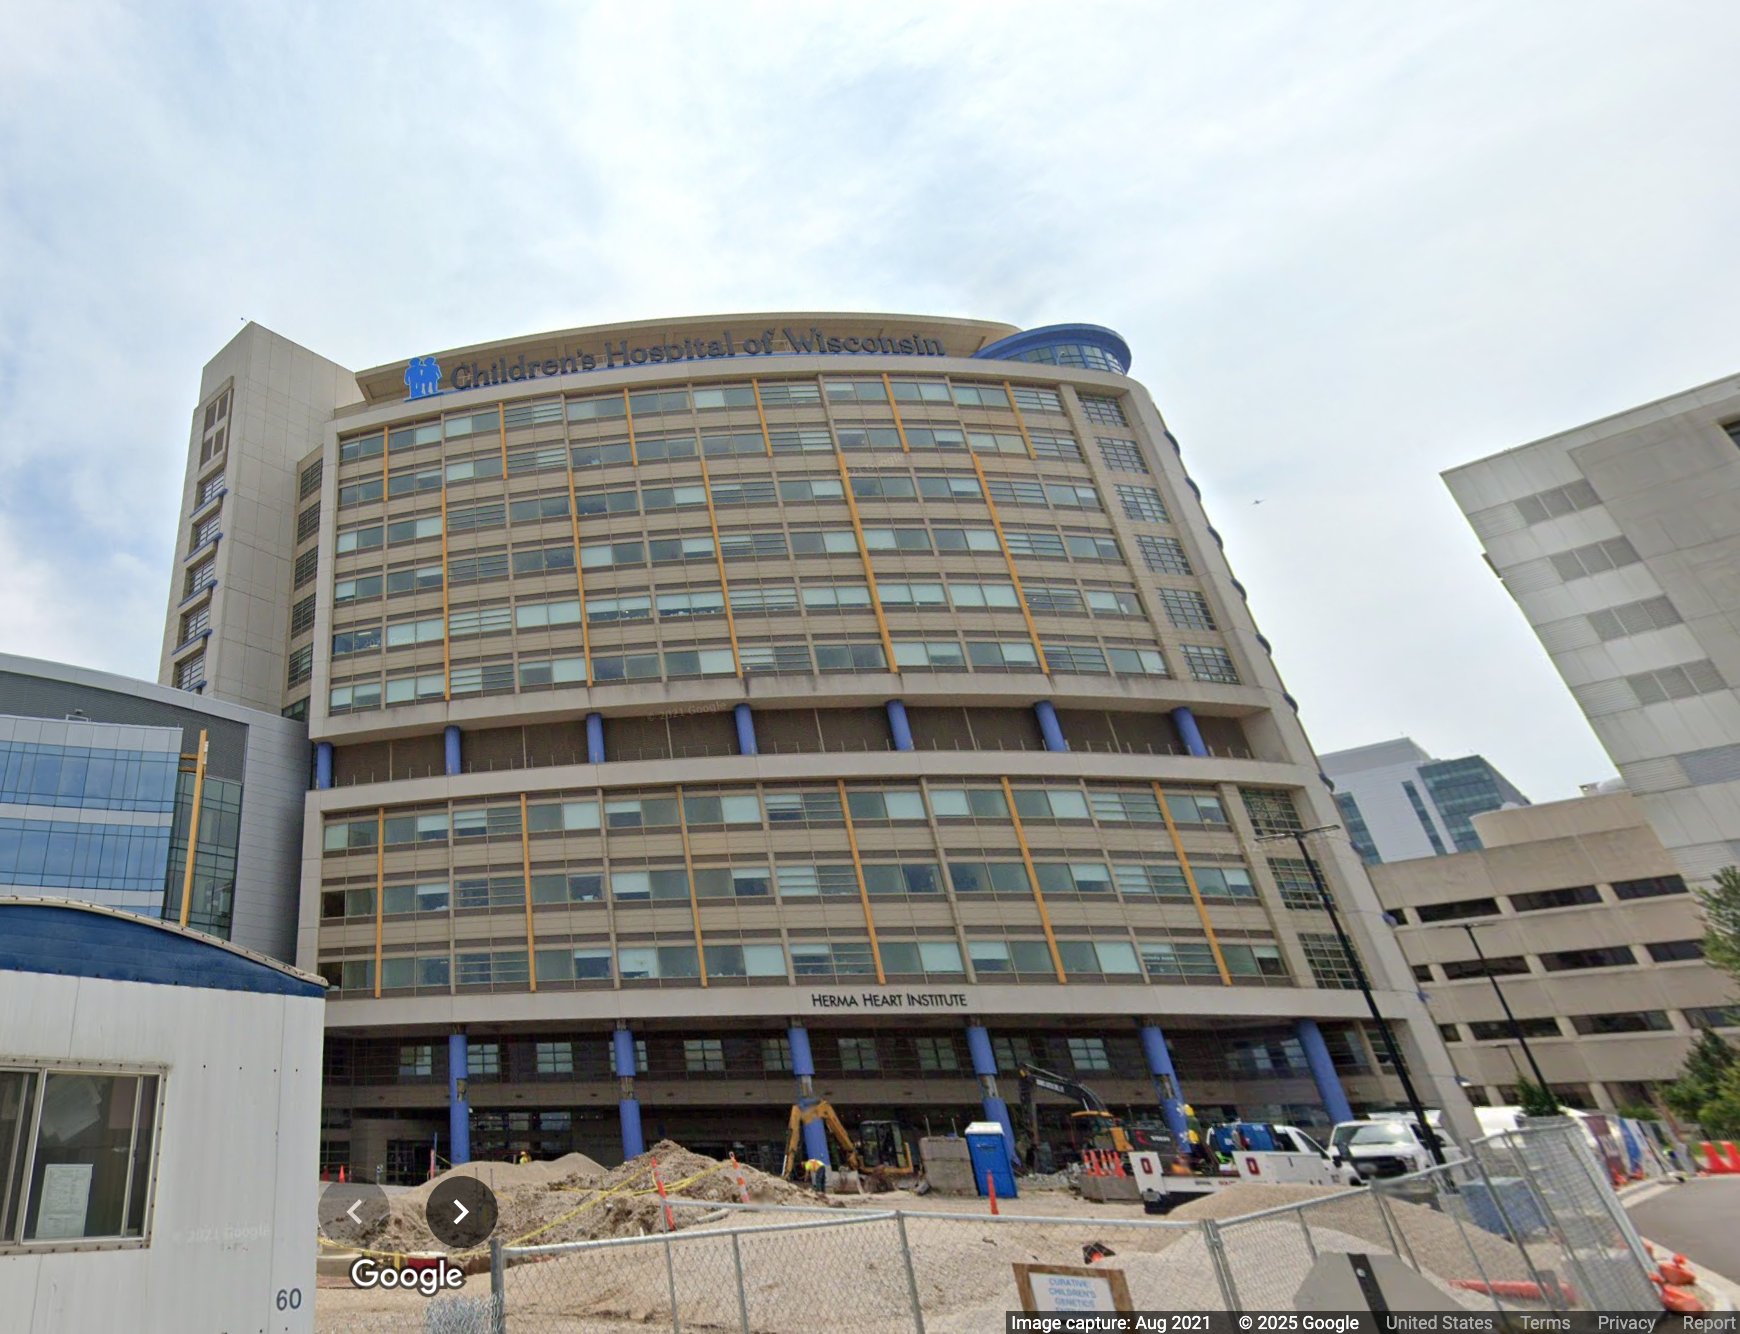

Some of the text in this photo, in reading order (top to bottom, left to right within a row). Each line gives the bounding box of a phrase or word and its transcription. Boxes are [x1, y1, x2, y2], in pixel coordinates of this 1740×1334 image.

[450, 327, 946, 389] Children's Hospital of Wisconsin
[811, 992, 968, 1007] HERMA HEART INSTITUTE
[276, 1288, 302, 1311] 60
